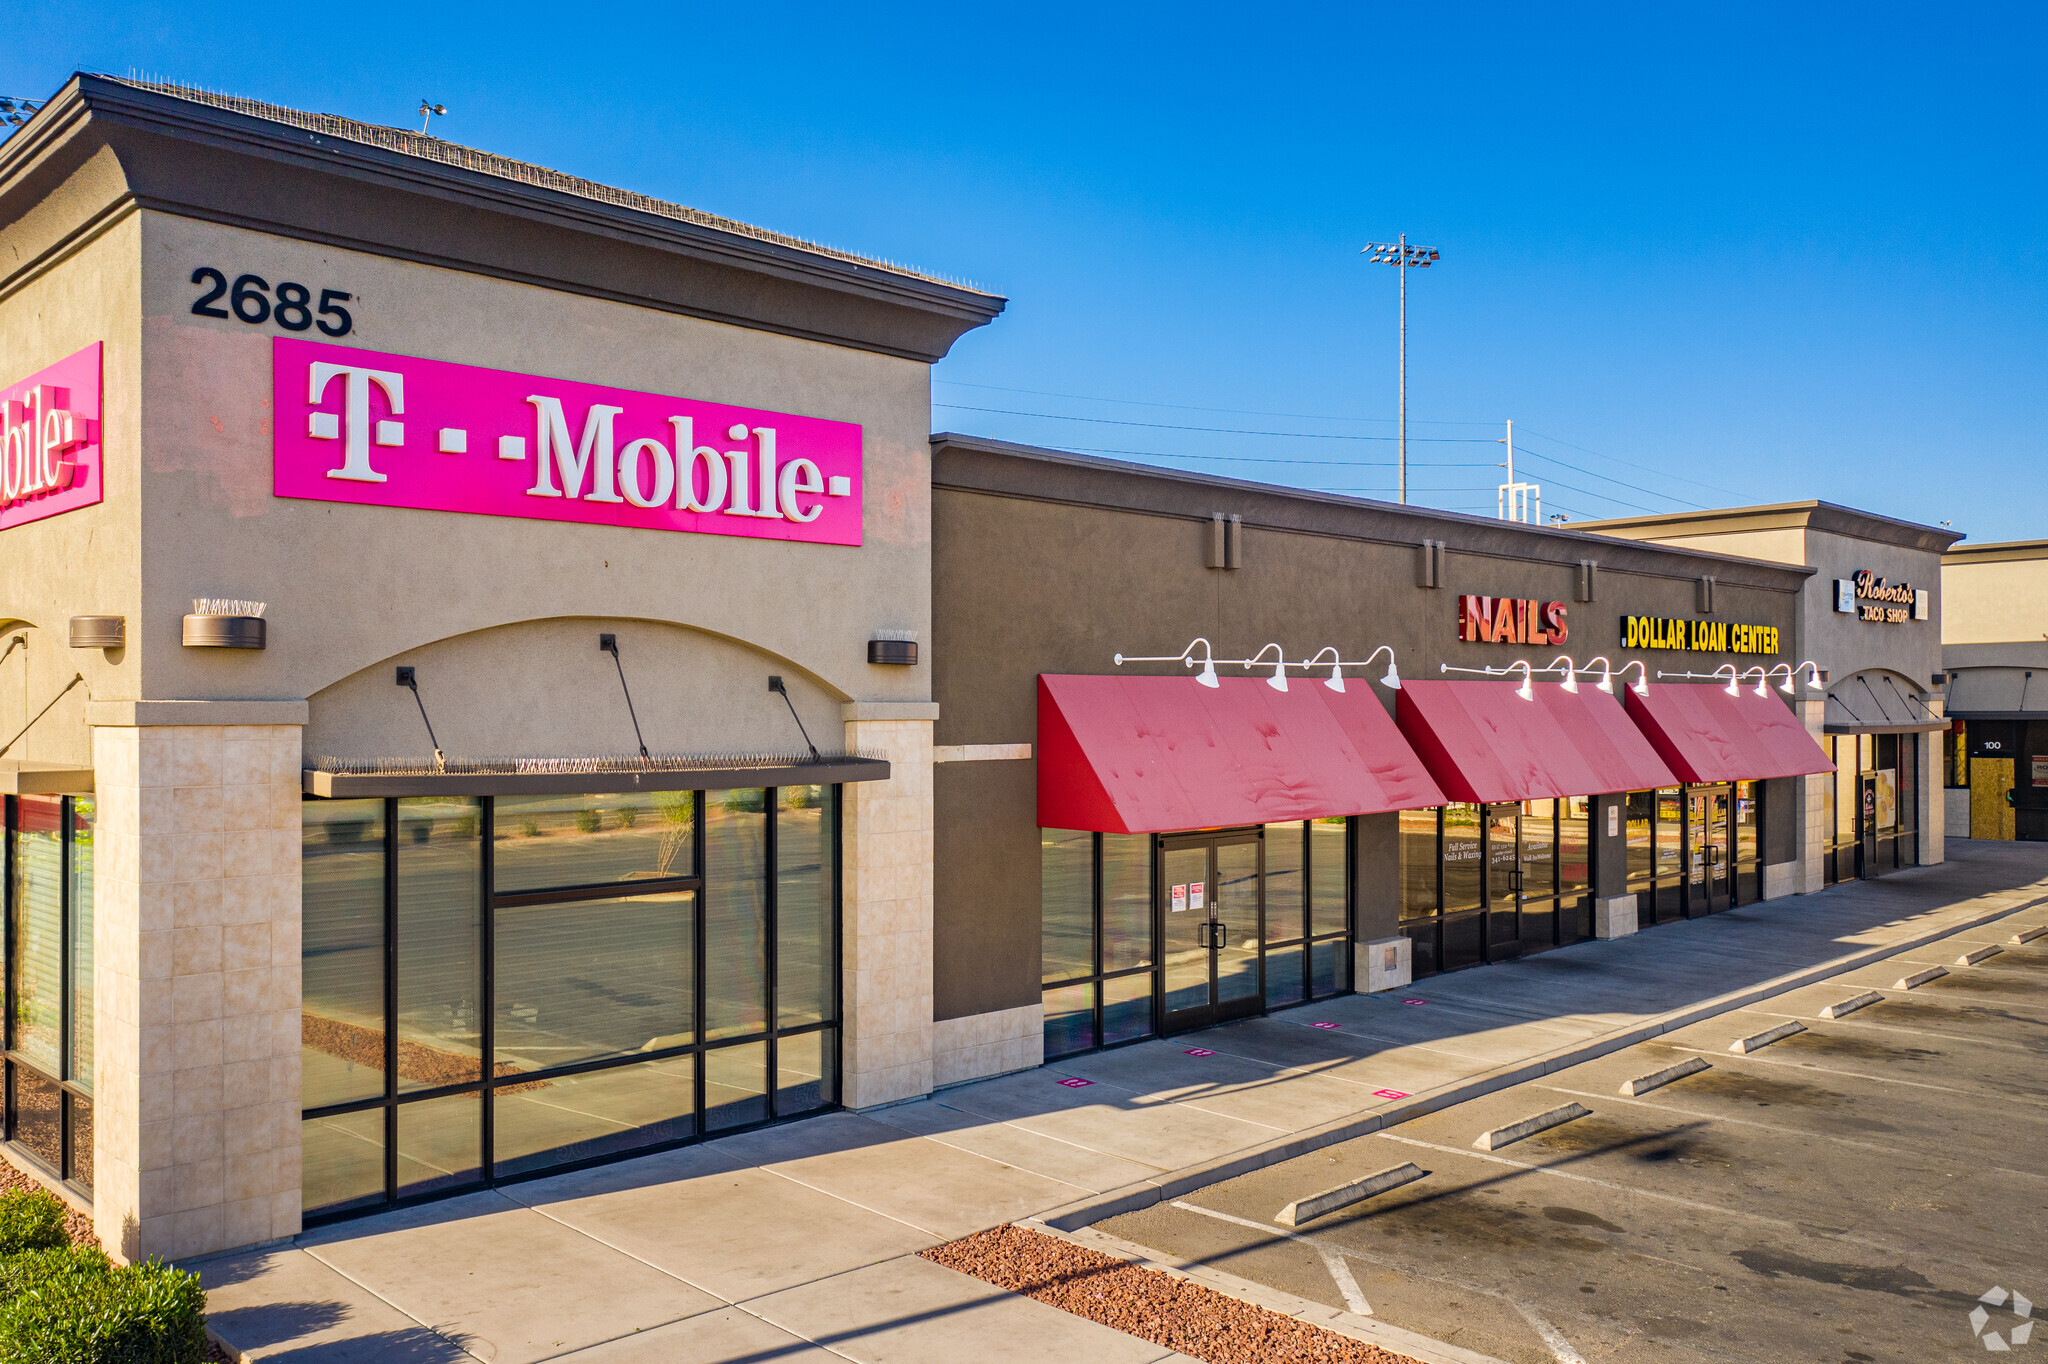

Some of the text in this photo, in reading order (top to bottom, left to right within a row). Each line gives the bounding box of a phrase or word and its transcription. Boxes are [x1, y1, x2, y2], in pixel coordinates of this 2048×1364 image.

[191, 266, 353, 337] 2685
[1857, 569, 1914, 604] Roberto's
[1459, 594, 1568, 646] NAILS
[1863, 605, 1908, 623] TACO SHOP
[1627, 615, 1779, 655] DOLLAR LOAN CENTER
[1984, 741, 2001, 749] 100
[1444, 852, 1457, 861] Nails
[1463, 850, 1482, 860] Waxing
[1449, 841, 1478, 851] Full Service
